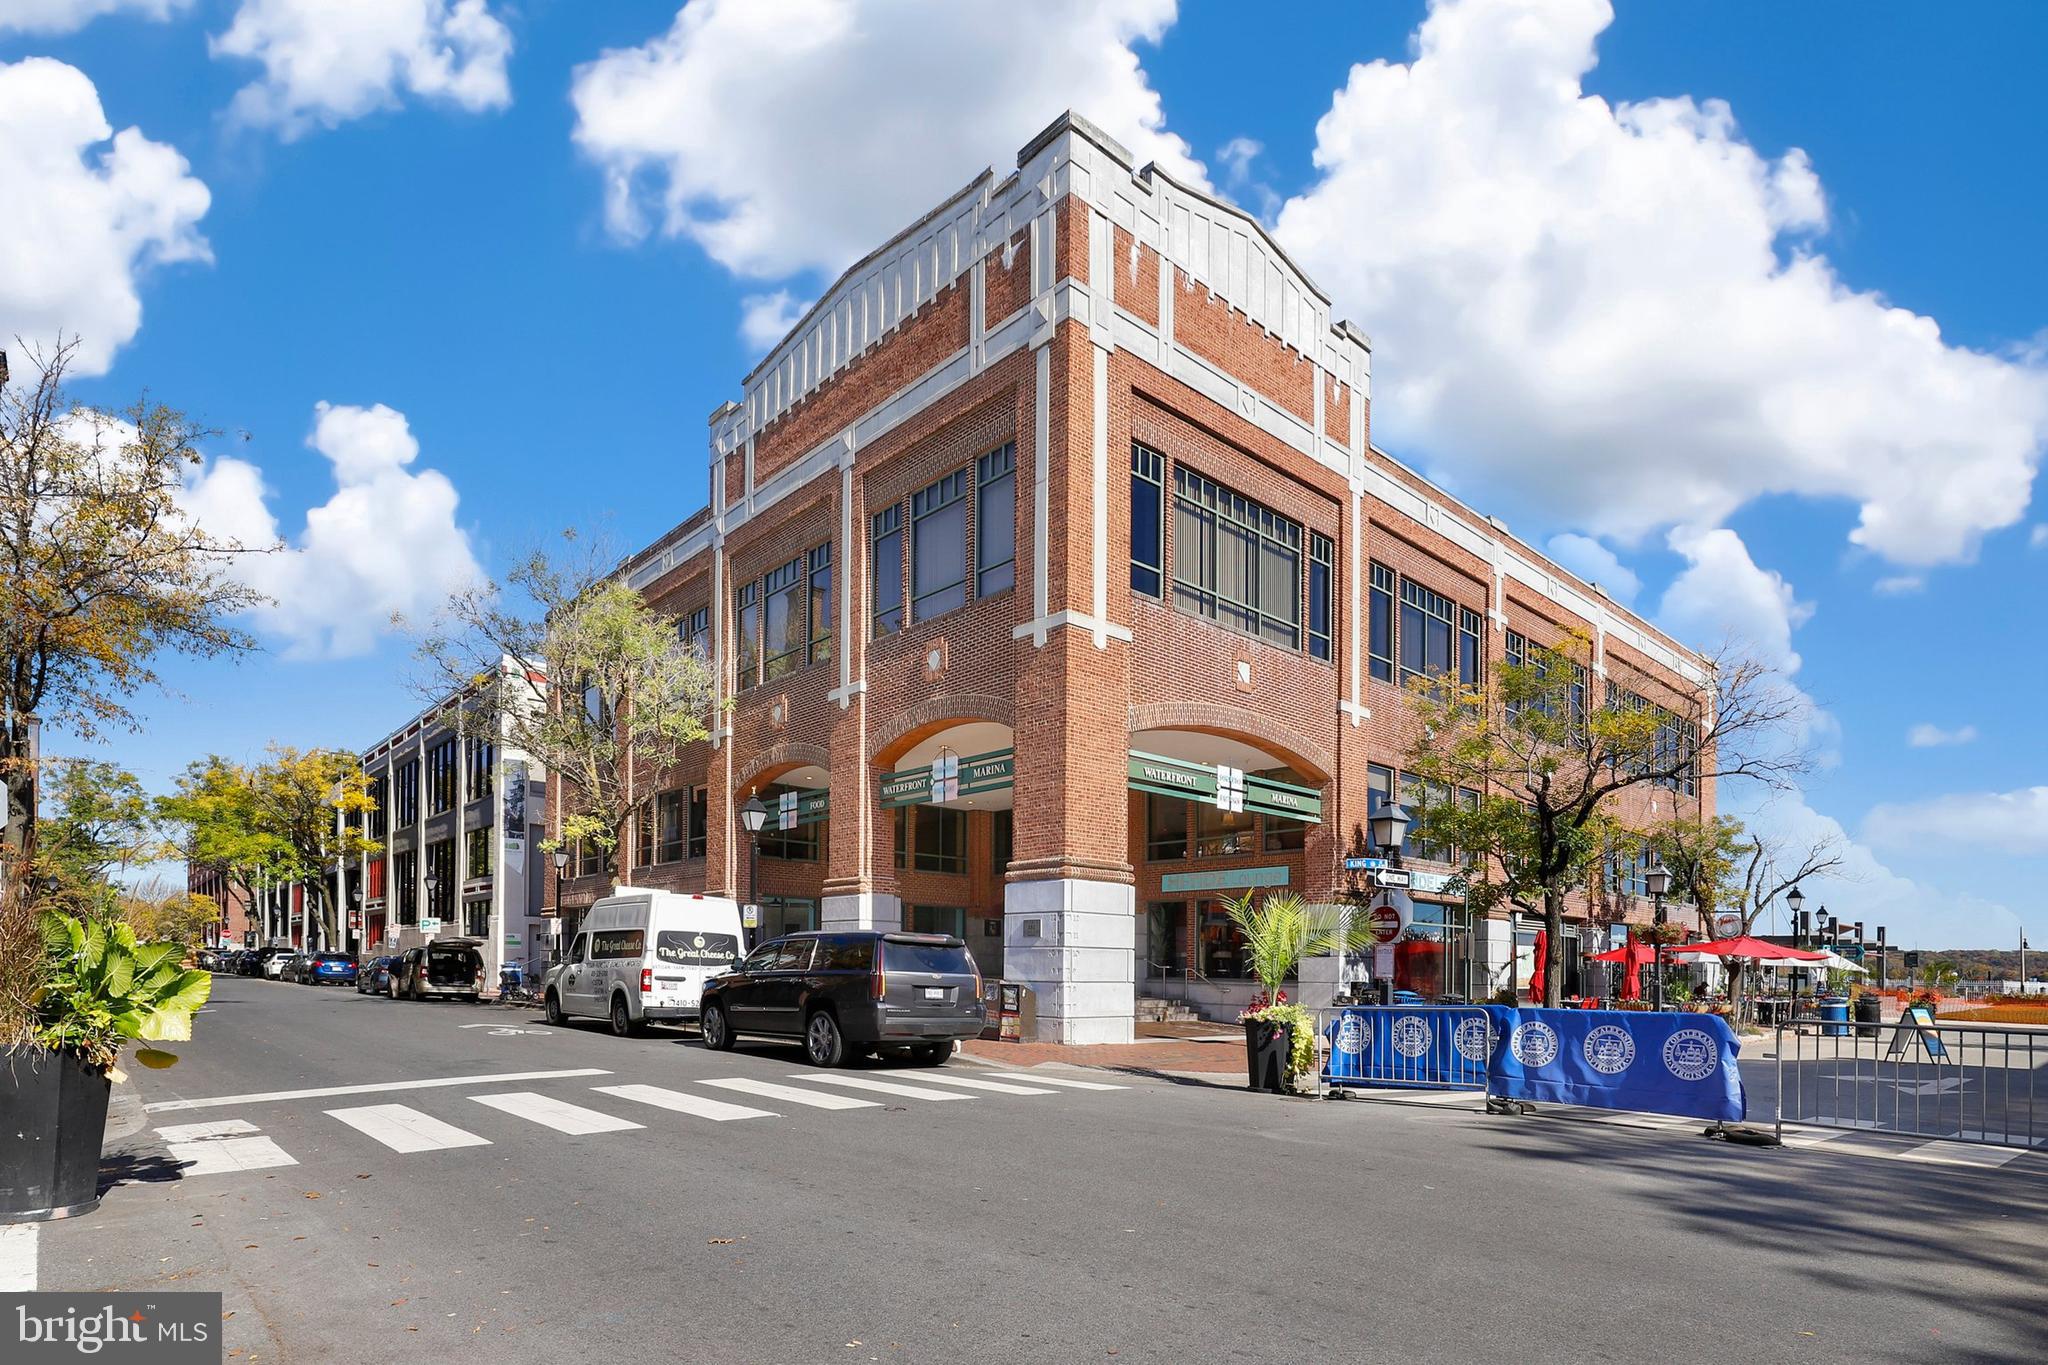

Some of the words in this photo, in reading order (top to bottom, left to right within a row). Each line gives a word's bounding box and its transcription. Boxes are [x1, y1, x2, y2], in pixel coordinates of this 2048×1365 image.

[882, 778, 927, 796] WATERFRONT
[973, 763, 1006, 779] MARINA
[1143, 766, 1198, 788] WATERFRONT
[1270, 793, 1299, 807] MARINA
[1350, 859, 1367, 867] KING
[1385, 873, 1396, 881] ONE
[1396, 875, 1408, 883] WAY
[421, 919, 431, 931] P
[601, 940, 610, 951] The
[609, 940, 621, 954] Great
[621, 939, 635, 950] Cheese
[658, 946, 677, 958] The
[677, 947, 700, 960] Great
[700, 949, 725, 960] Cheese
[1600, 1026, 1635, 1059] ALEXANDRIA
[1681, 1030, 1718, 1065] ALEXANDRIA
[1517, 1052, 1554, 1067] VIRGINIA
[1590, 1057, 1630, 1073] VIRGINIA
[1670, 1063, 1713, 1081] VIRGINIA
